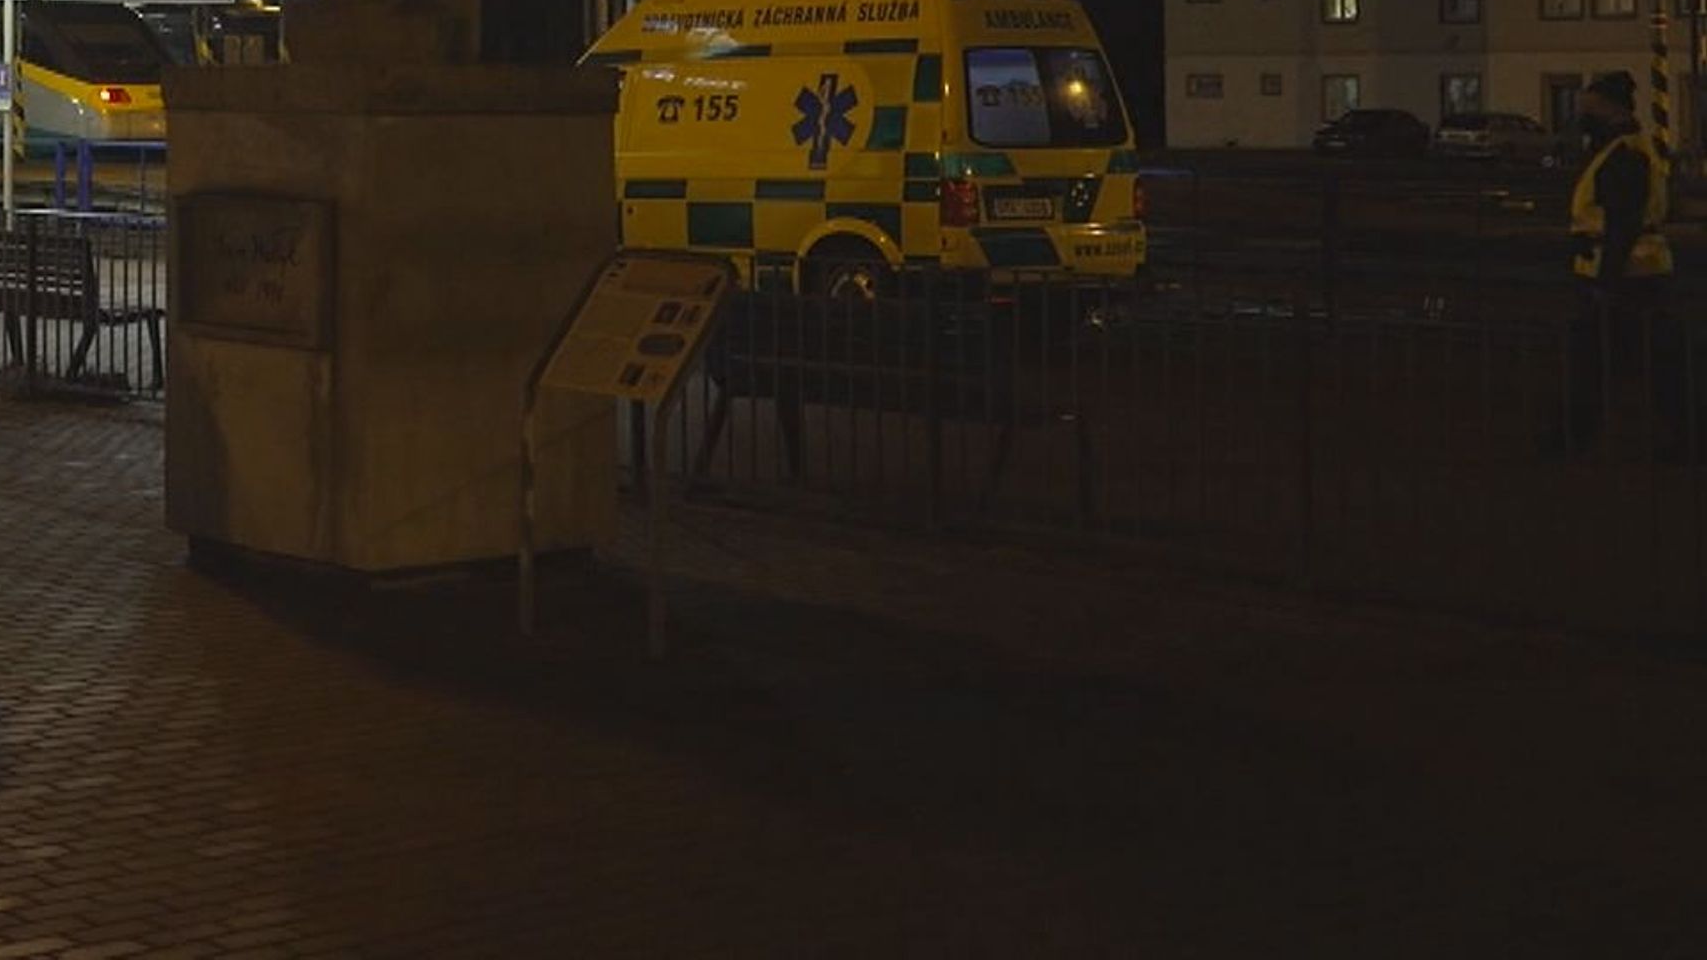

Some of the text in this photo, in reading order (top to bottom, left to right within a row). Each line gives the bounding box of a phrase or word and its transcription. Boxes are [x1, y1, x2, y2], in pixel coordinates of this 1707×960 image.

[754, 4, 847, 29] ZÁCHRANNÁ
[856, 0, 921, 23] SLUŽBA
[694, 94, 739, 121] 155
